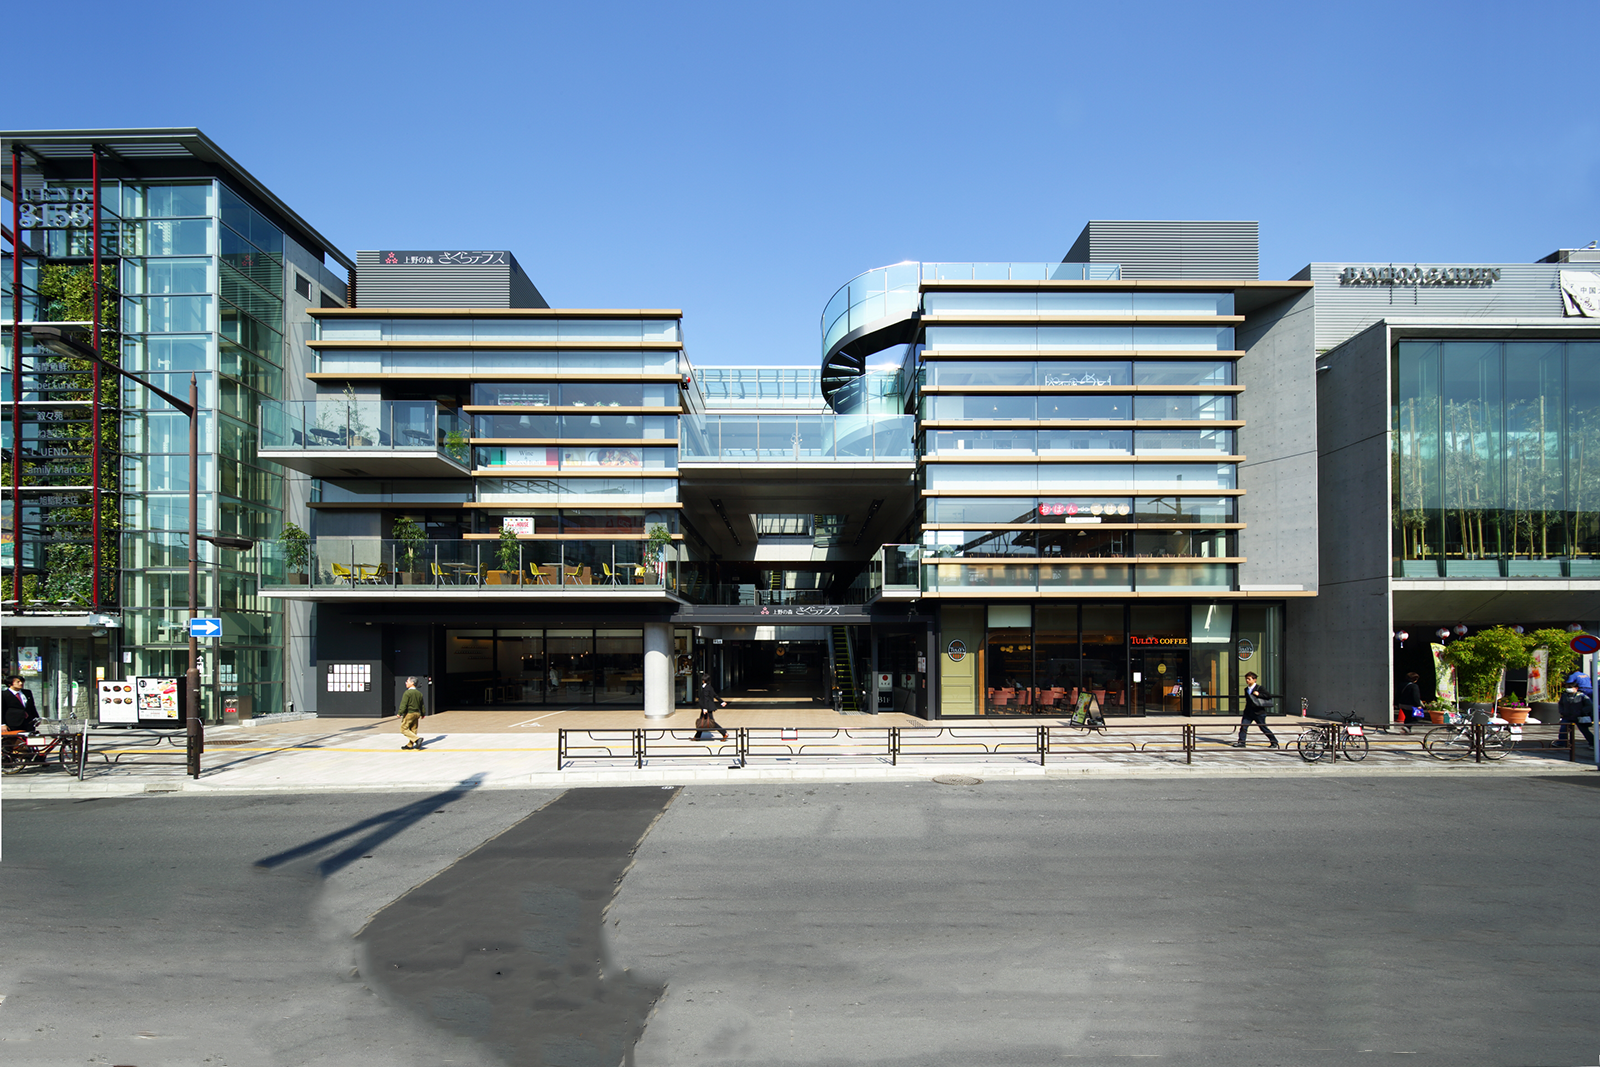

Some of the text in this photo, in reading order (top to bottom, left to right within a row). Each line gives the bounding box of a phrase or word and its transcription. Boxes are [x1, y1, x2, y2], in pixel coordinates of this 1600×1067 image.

[22, 187, 88, 201] UENO
[19, 203, 92, 228] 3153
[404, 251, 505, 265] 上野の森 さくらテラス
[1345, 267, 1500, 280] BAMBOO GARDEN
[41, 447, 69, 457] UENO
[795, 605, 840, 615] さくらテラス
[1130, 636, 1159, 645] TULLY'S
